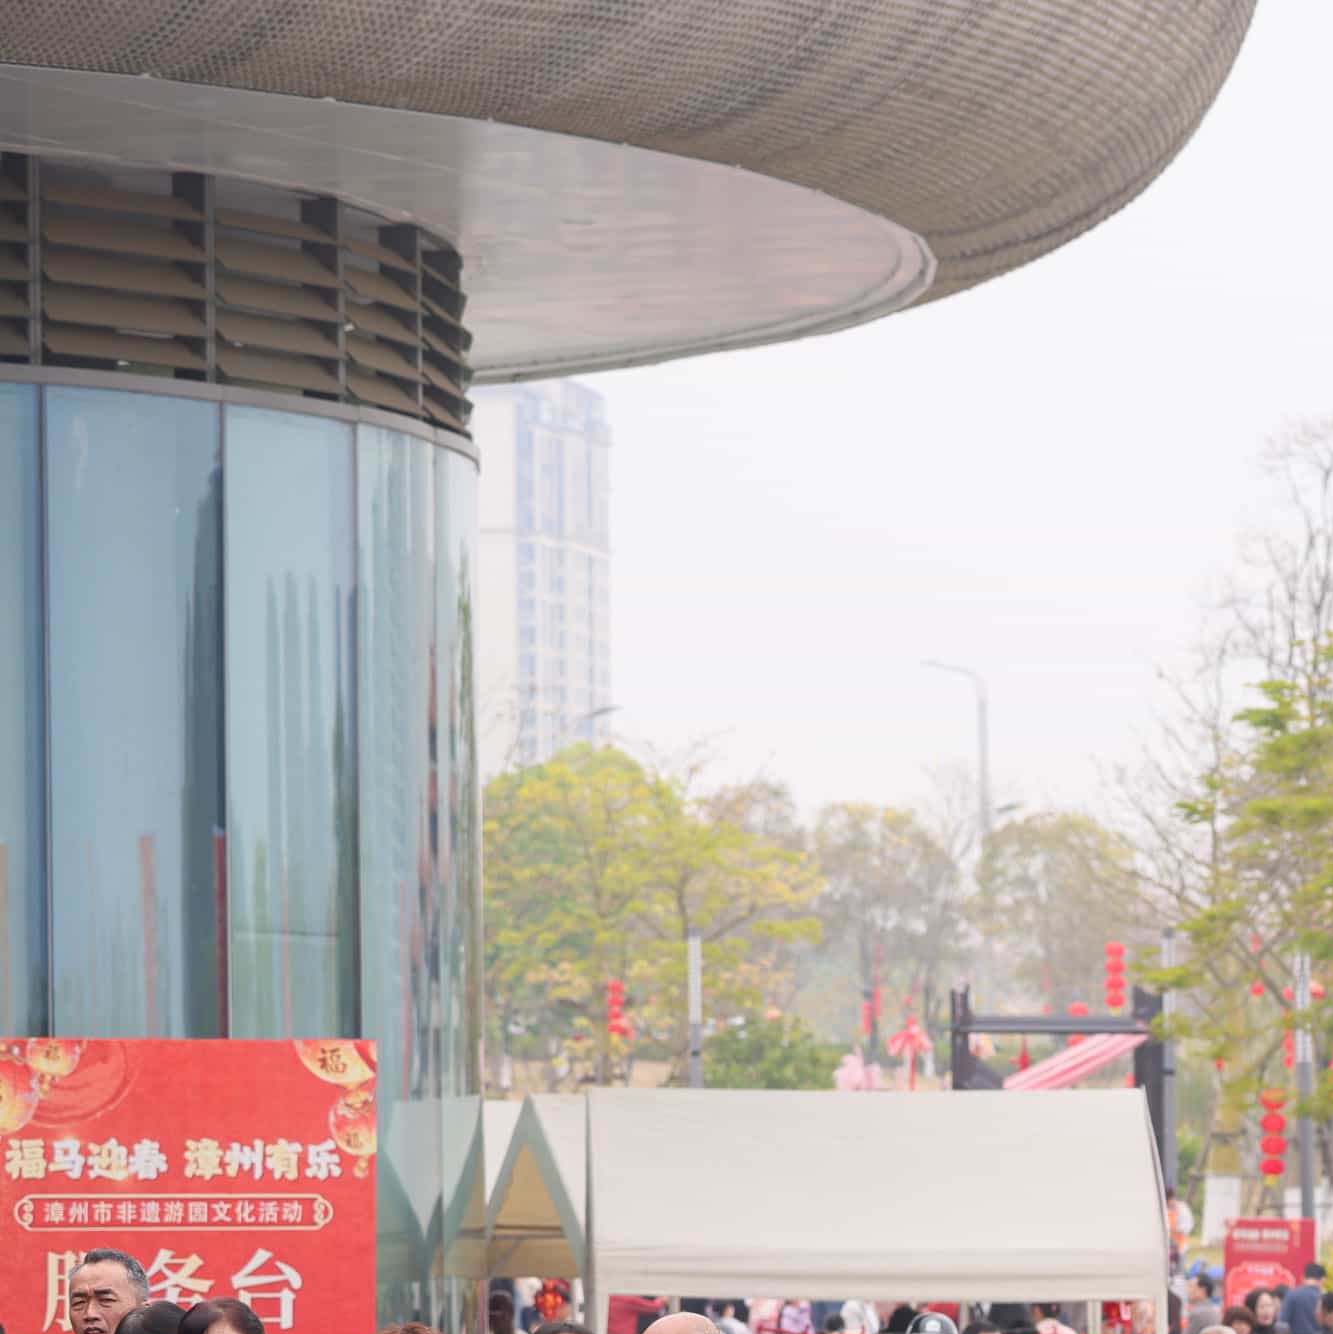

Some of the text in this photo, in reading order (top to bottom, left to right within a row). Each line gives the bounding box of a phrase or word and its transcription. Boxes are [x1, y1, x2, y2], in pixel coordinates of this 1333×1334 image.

[317, 1047, 347, 1074] 福
[5, 1137, 343, 1181] 福马迎春 漳州有乐
[43, 1200, 303, 1224] 漳州市非遗游园文化活动
